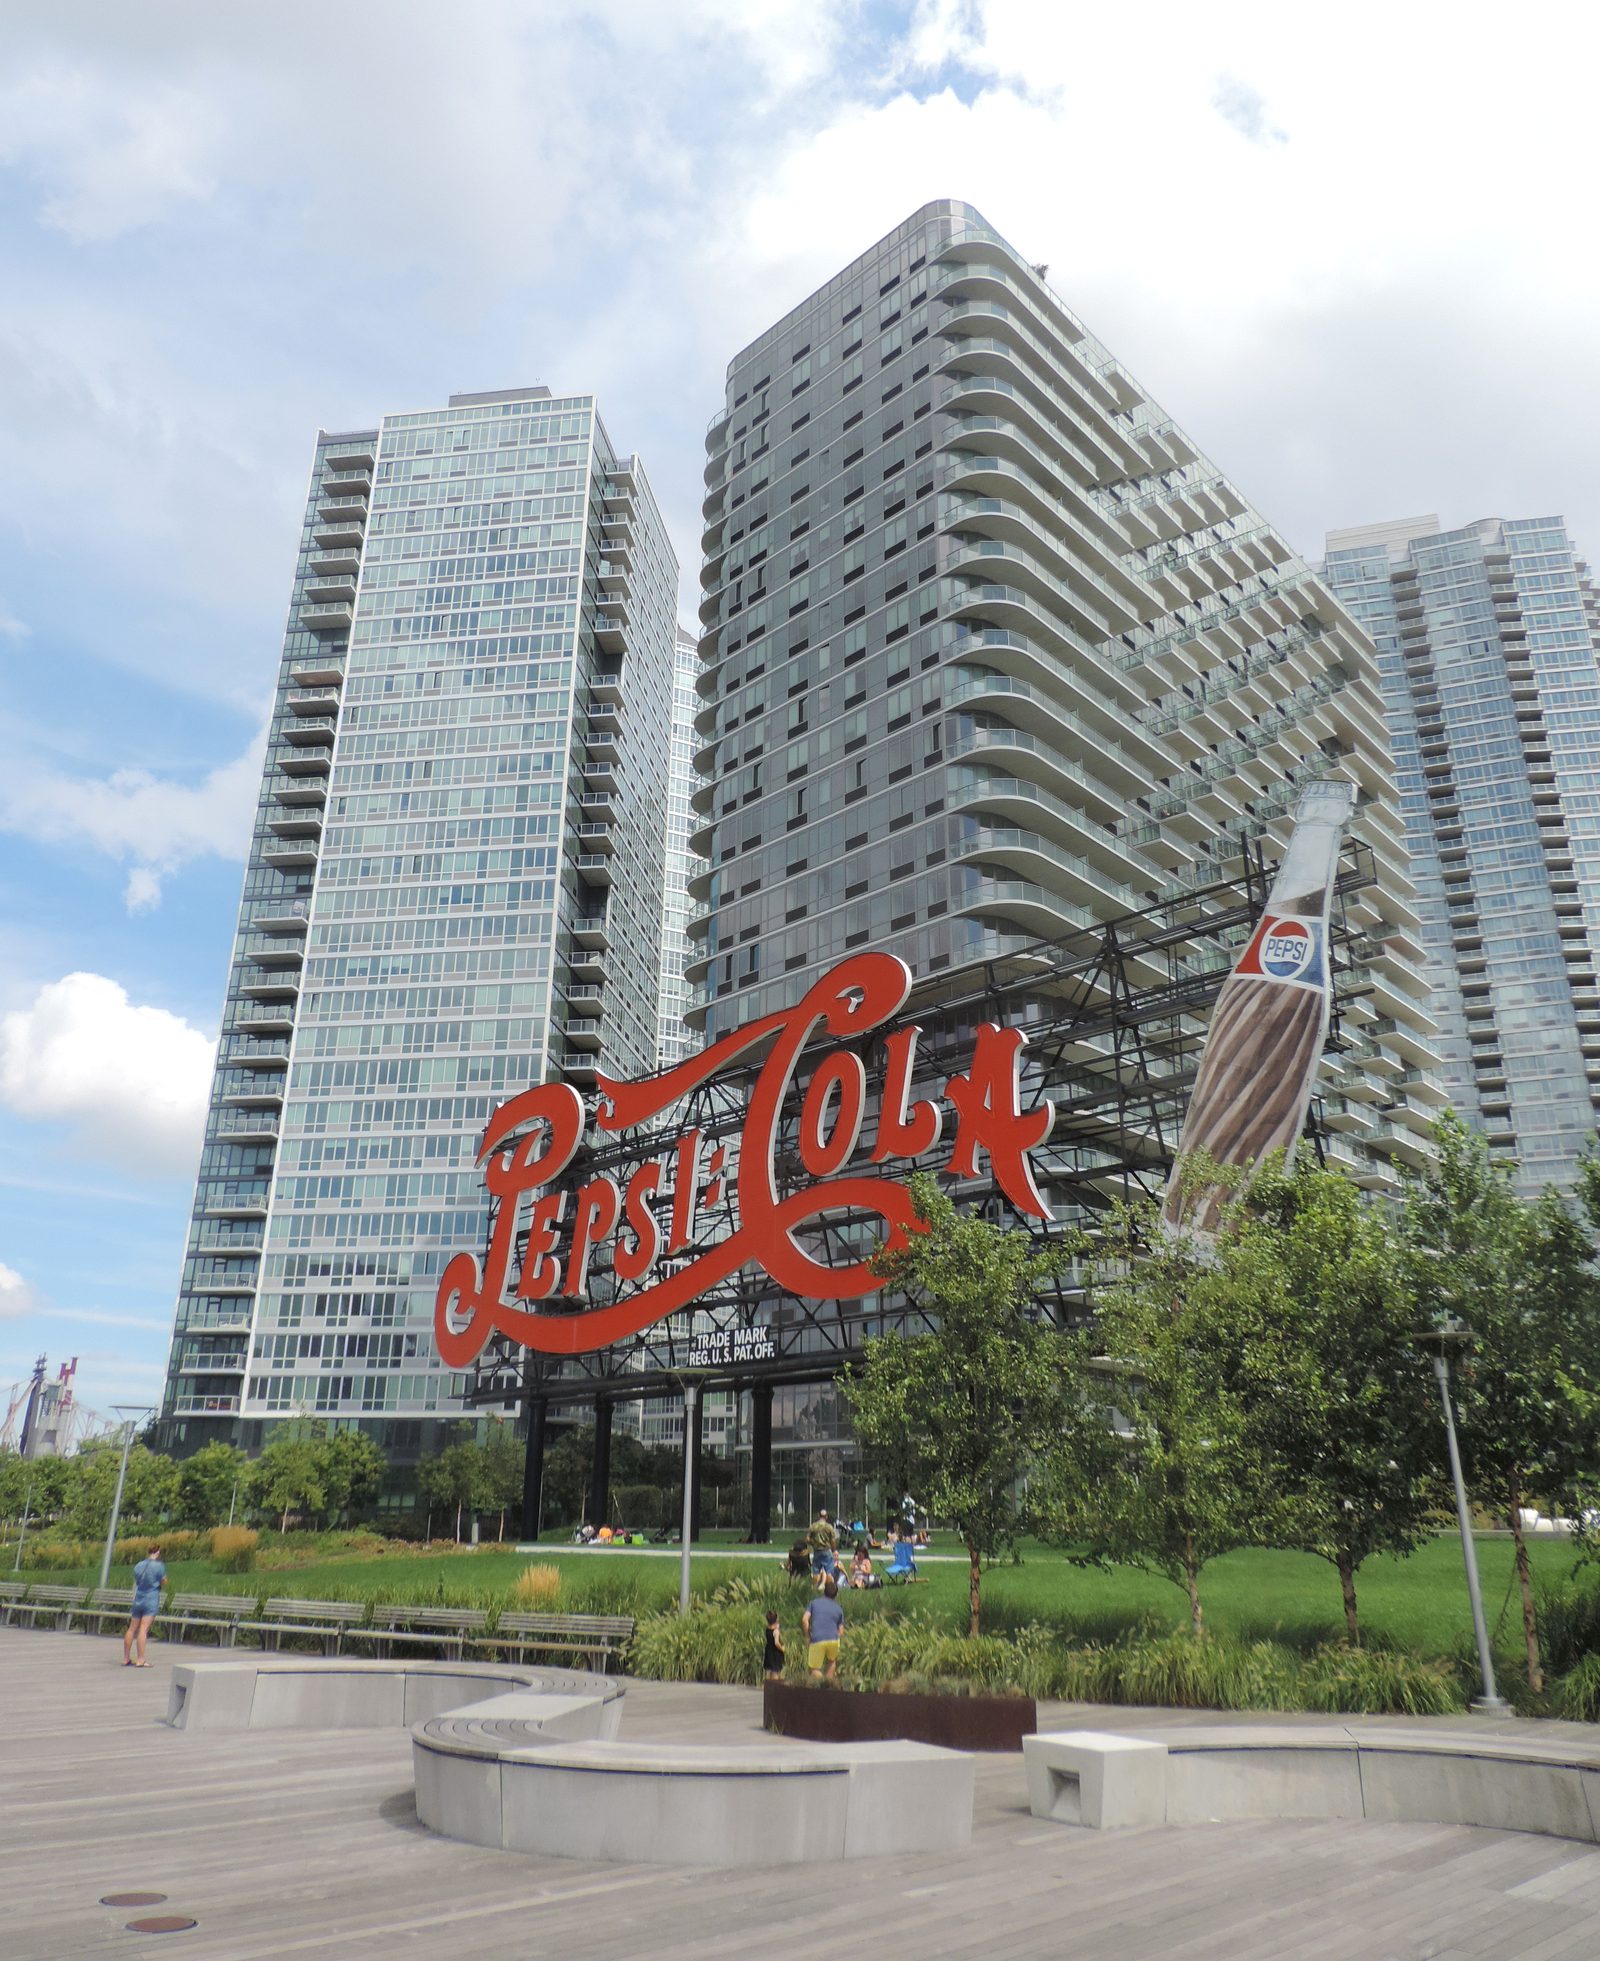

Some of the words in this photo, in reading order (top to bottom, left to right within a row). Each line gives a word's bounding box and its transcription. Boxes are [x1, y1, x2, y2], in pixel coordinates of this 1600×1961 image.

[1265, 938, 1308, 962] PEPSI
[697, 1330, 730, 1350] TRADE
[734, 1326, 767, 1345] MARK
[689, 1350, 711, 1367] REG.
[733, 1344, 754, 1362] PAT.
[754, 1341, 775, 1360] OFF.
